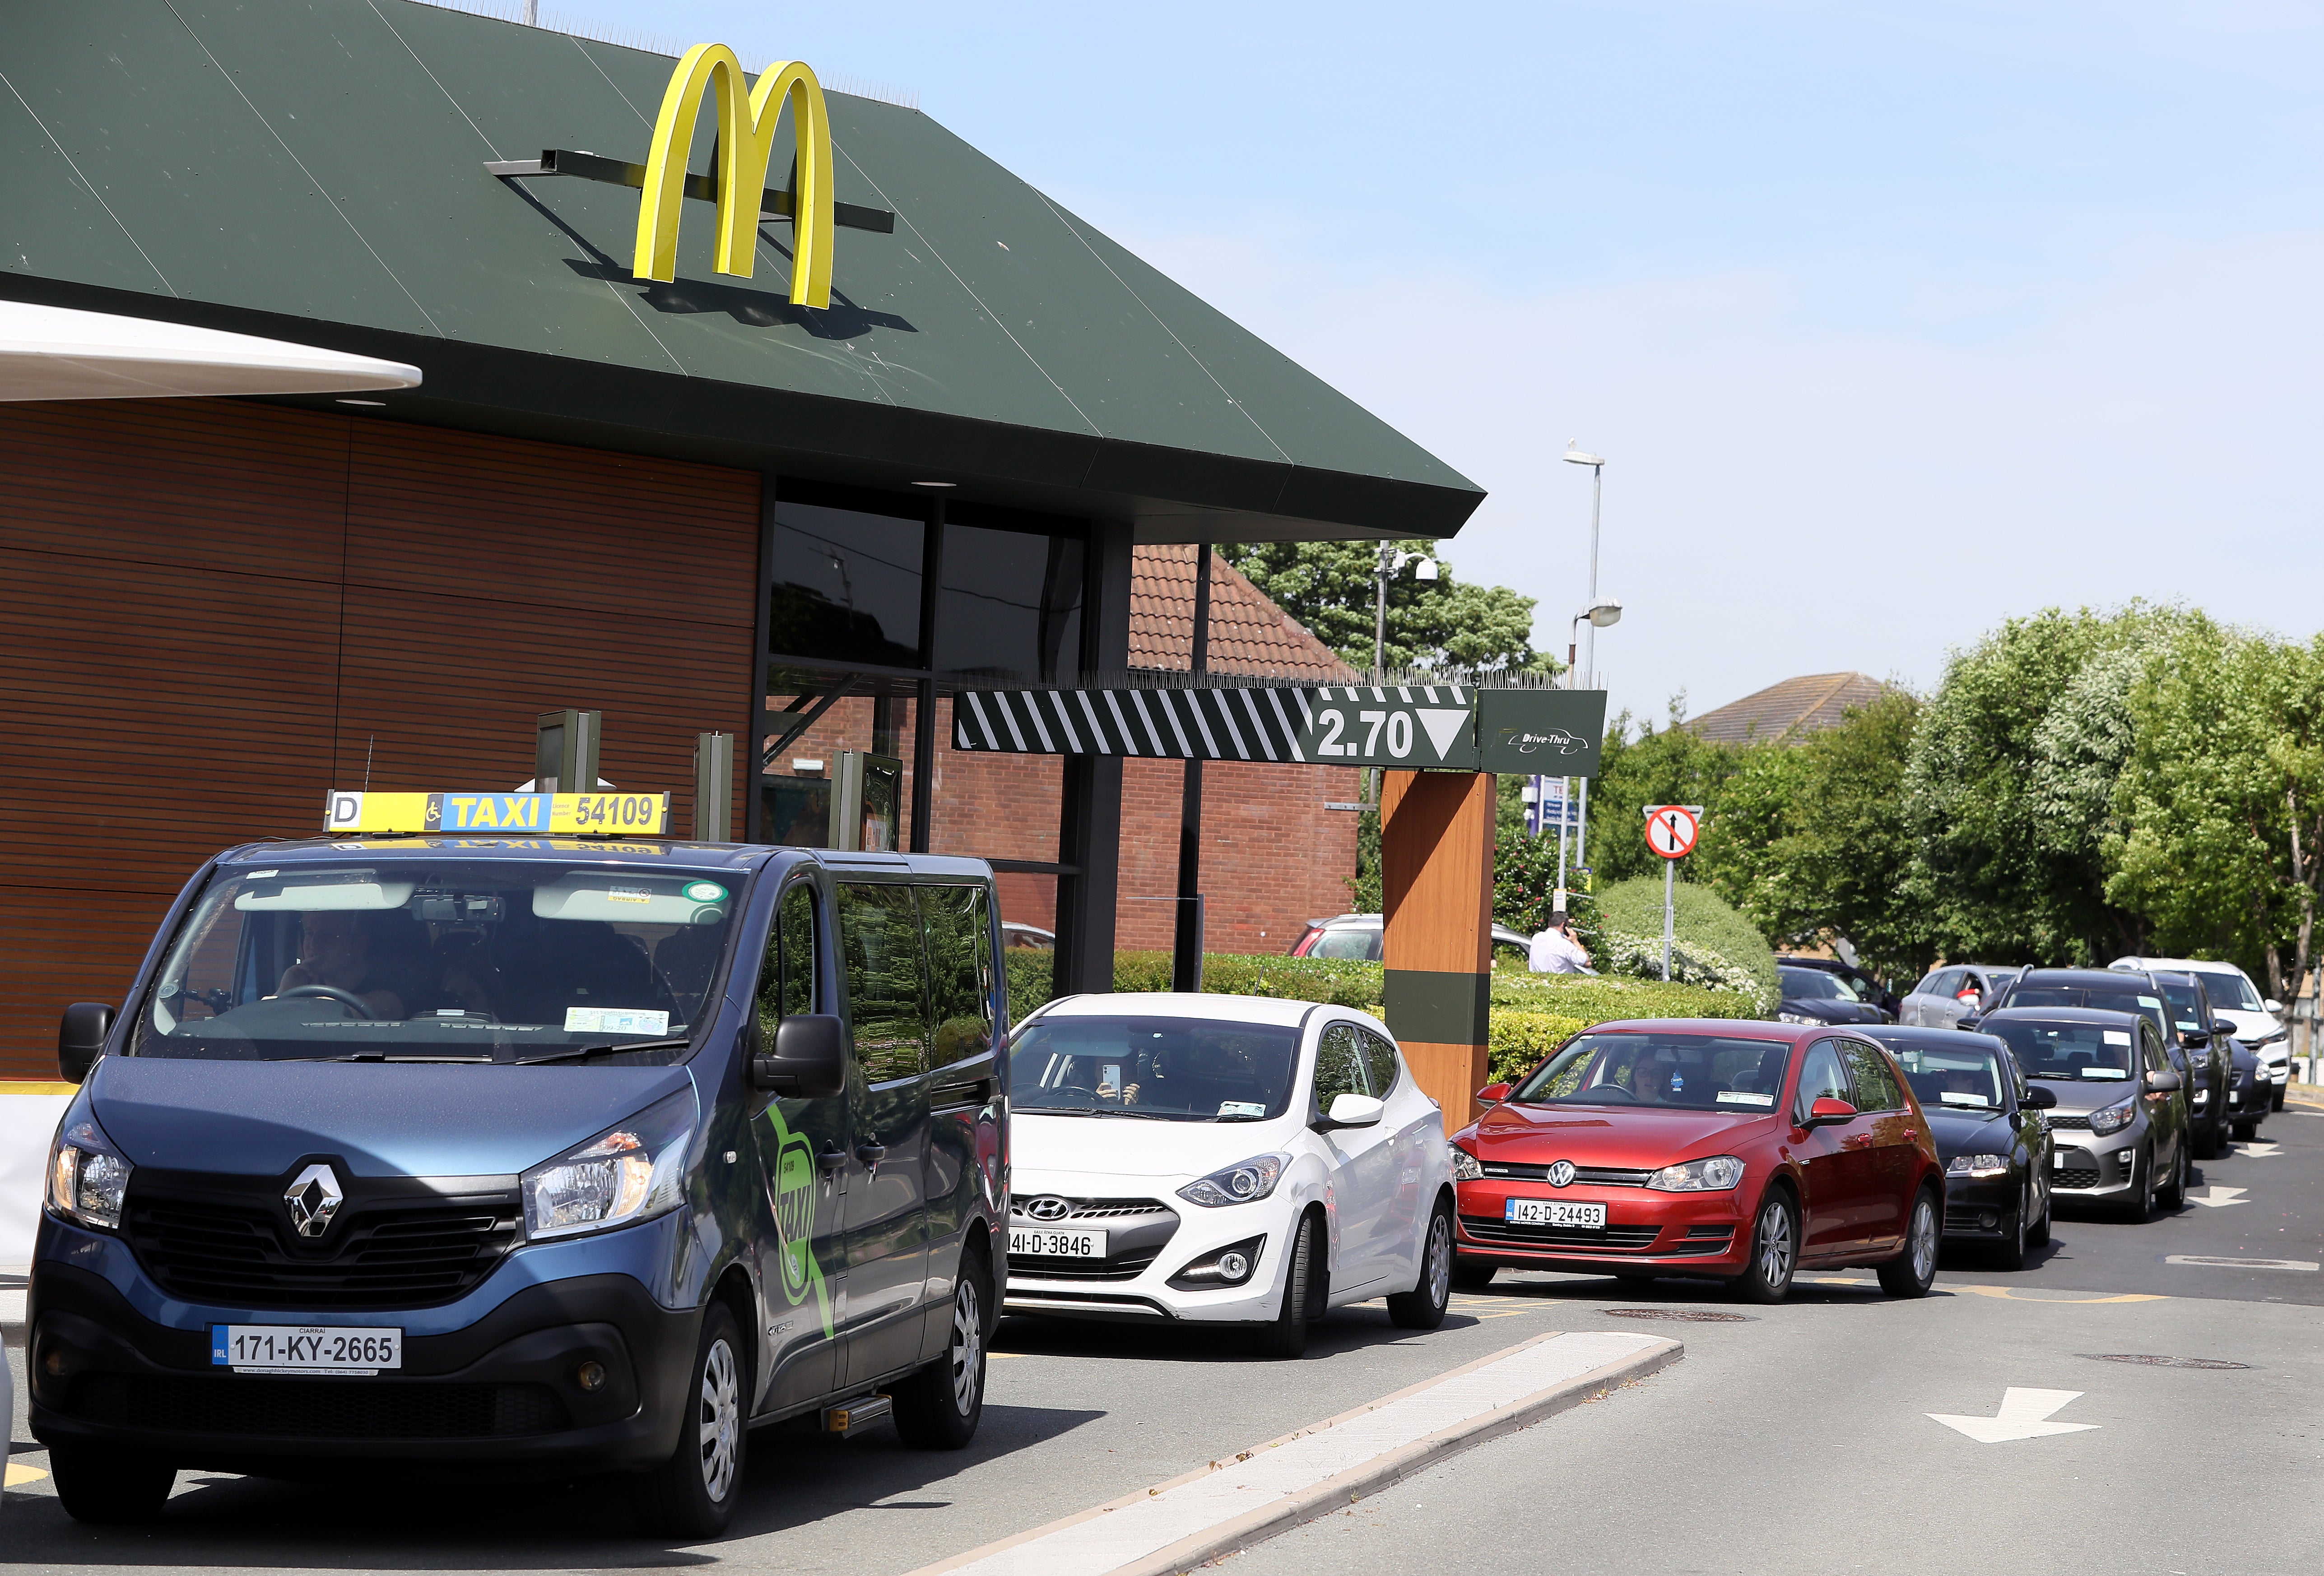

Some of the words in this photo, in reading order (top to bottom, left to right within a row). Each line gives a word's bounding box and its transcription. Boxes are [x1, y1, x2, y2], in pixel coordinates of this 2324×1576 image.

[1317, 709, 1413, 759] 2.70
[1522, 733, 1571, 745] Drive-Thru
[335, 797, 357, 822] D
[451, 797, 540, 827] TAXI
[576, 797, 653, 825] 54109
[784, 1160, 795, 1173] 54109
[780, 1184, 811, 1243] TAXI
[1518, 1204, 1600, 1223] 142-D-24493
[1008, 1233, 1091, 1255] 141-D-3846
[214, 1349, 227, 1358] IRL
[235, 1335, 393, 1362] 171-KY-2665
